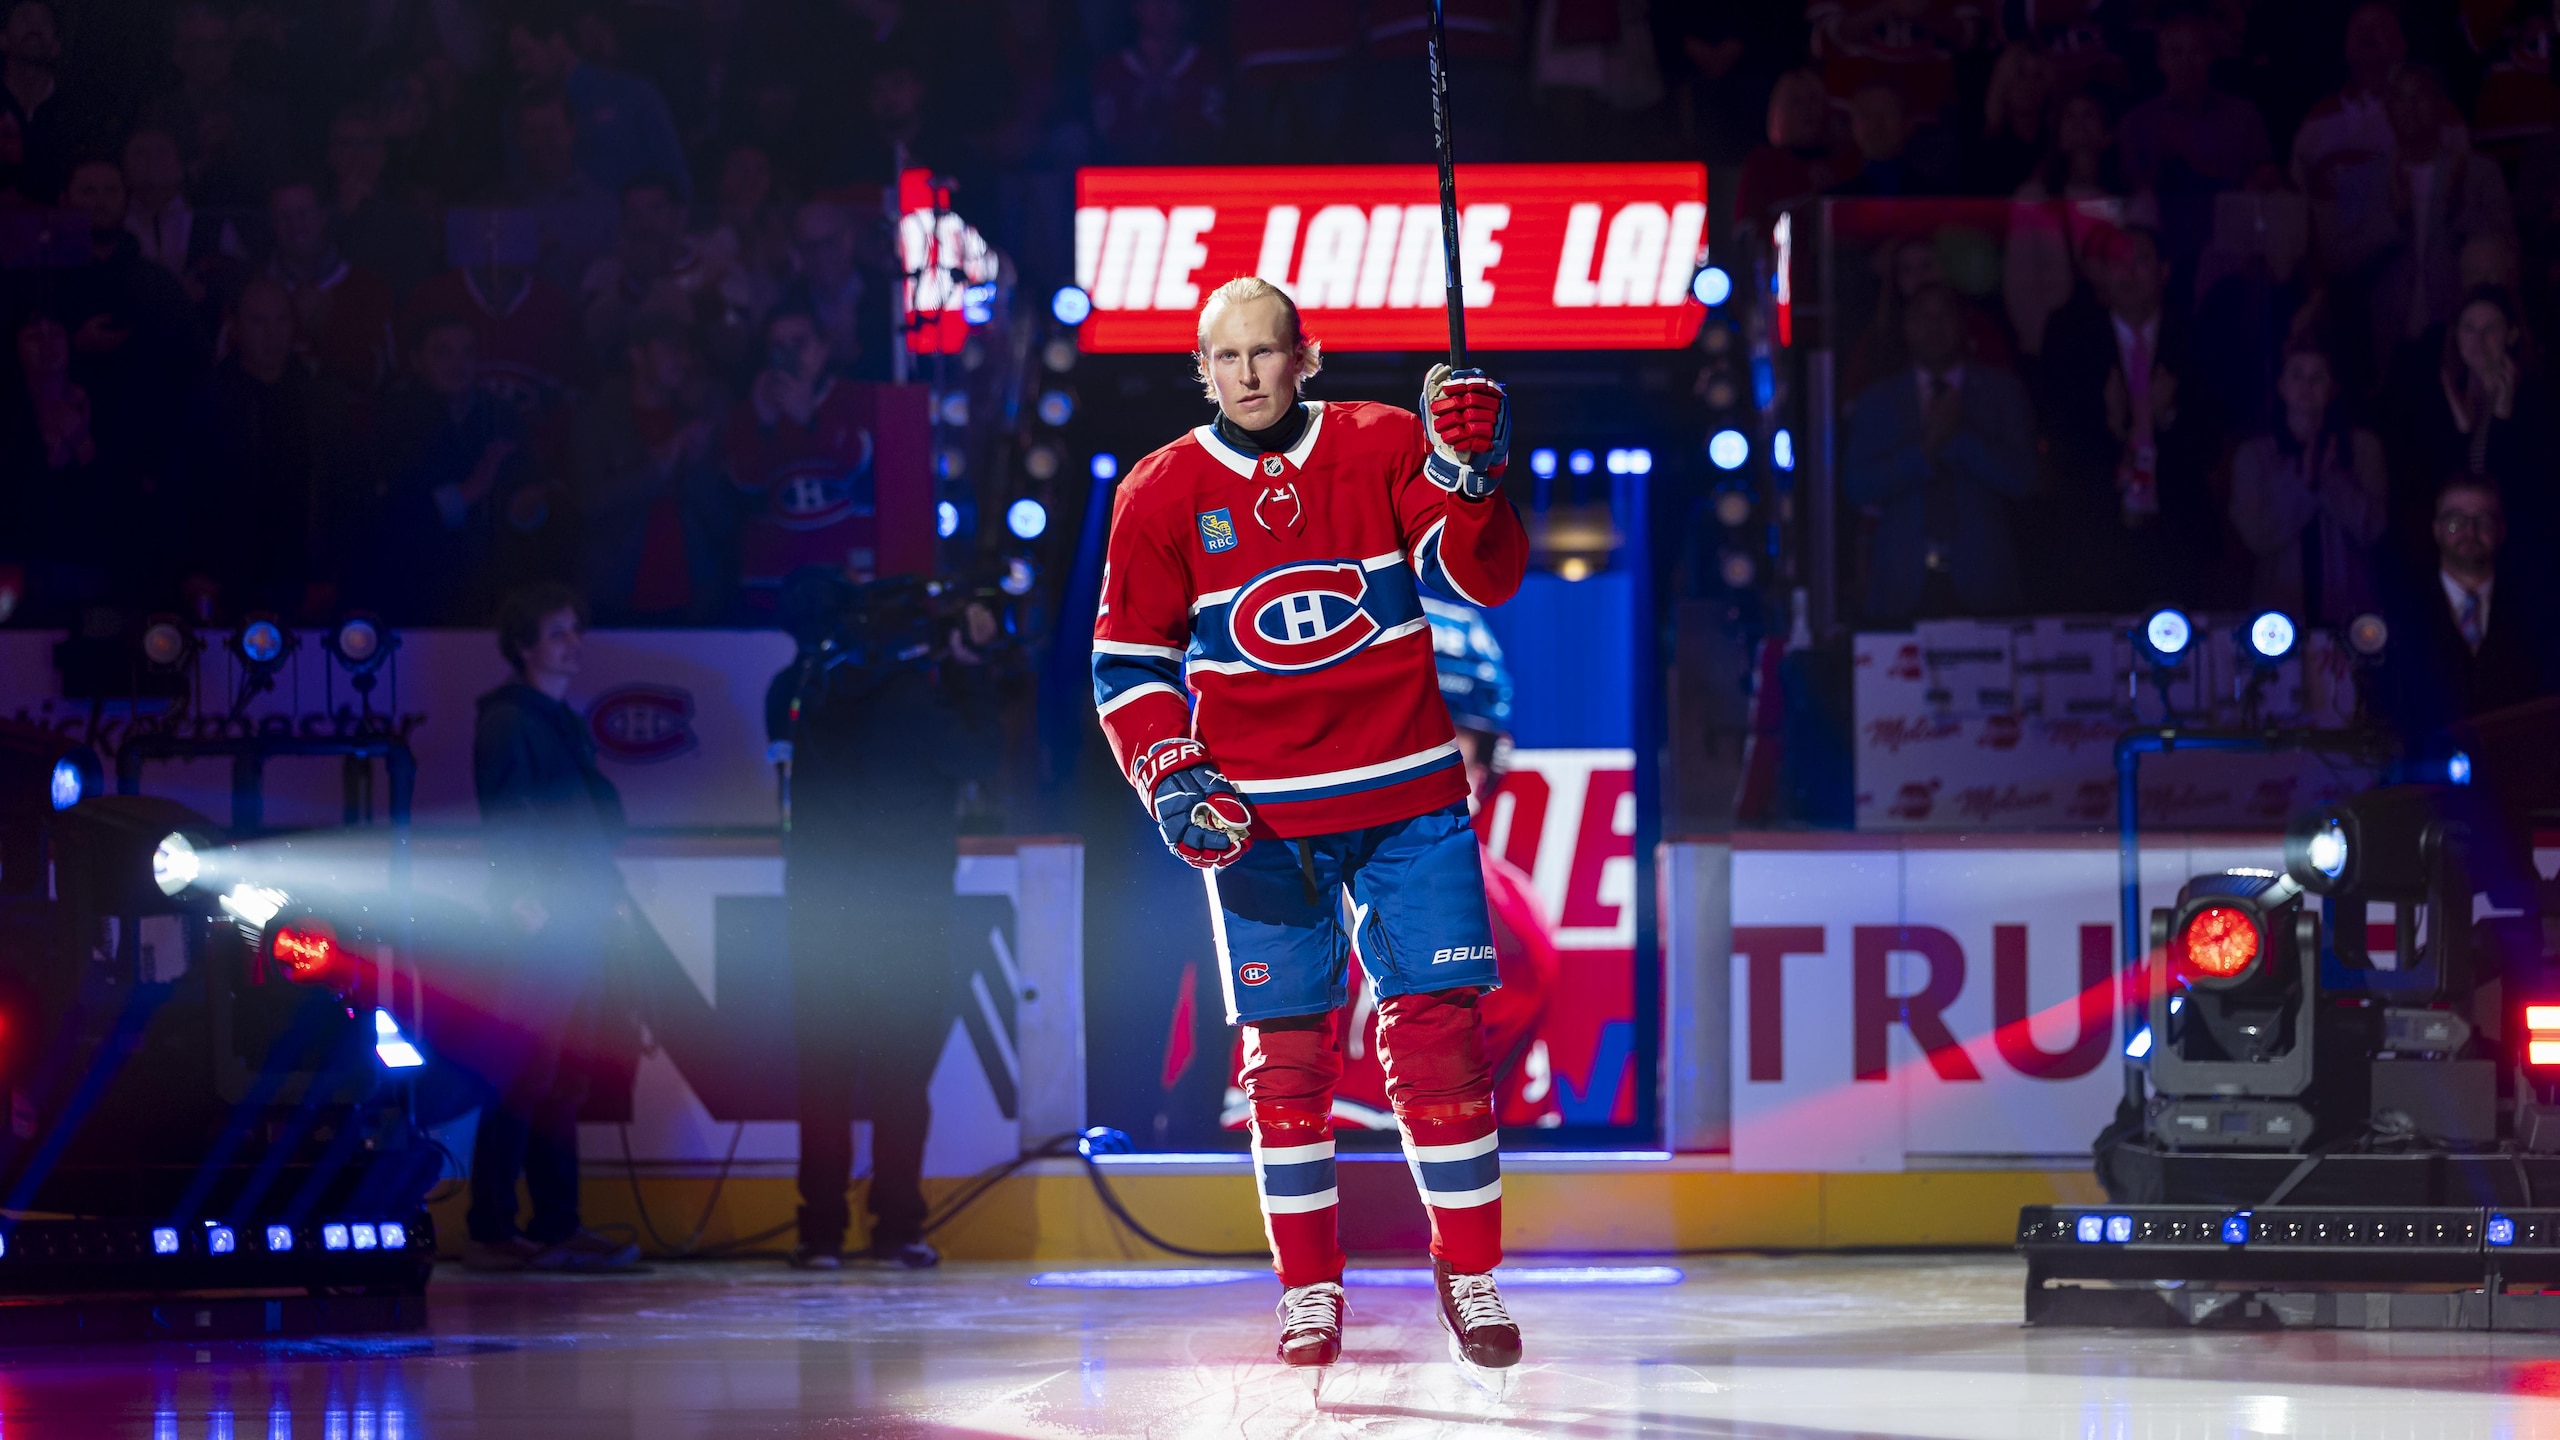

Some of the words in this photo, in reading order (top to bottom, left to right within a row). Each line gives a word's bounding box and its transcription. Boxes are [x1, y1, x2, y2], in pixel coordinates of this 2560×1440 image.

[1429, 40, 1442, 132] BAUER
[1254, 203, 1511, 309] LAINE
[1428, 467, 1451, 484] BAUER
[1208, 536, 1235, 550] RBC
